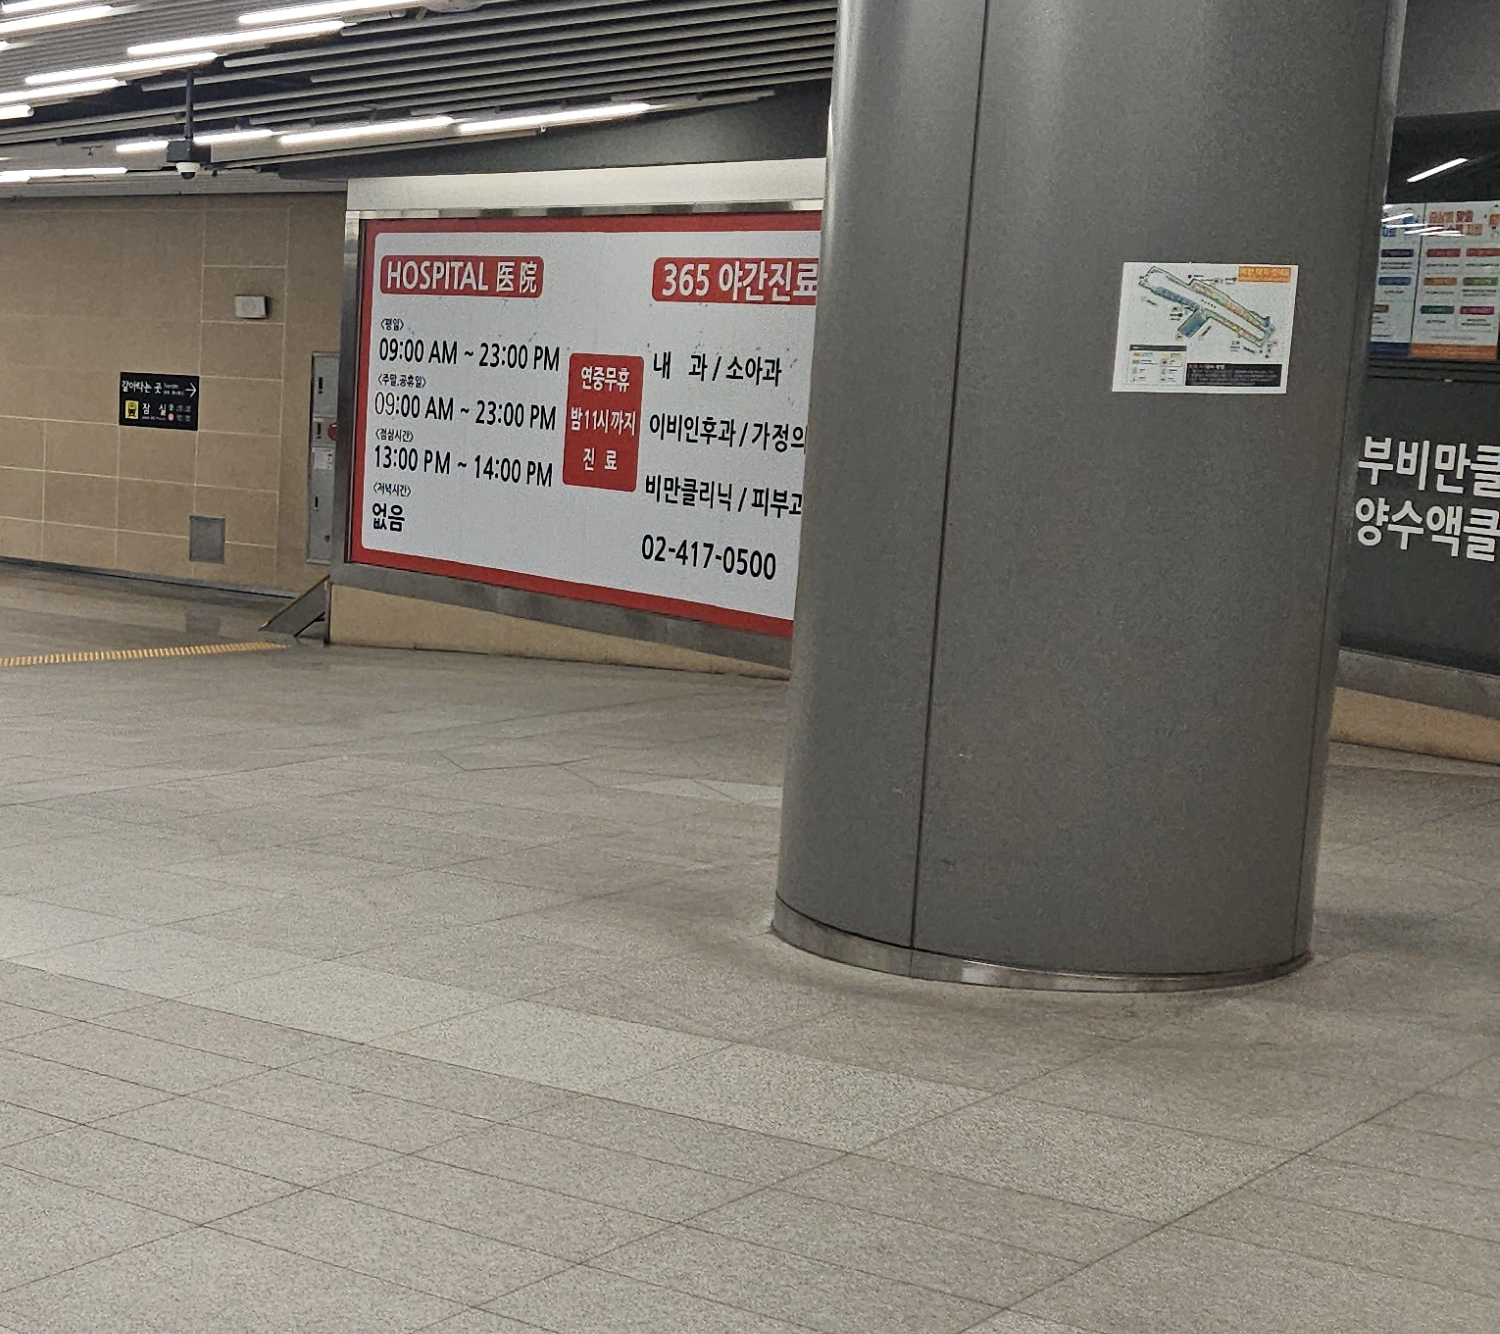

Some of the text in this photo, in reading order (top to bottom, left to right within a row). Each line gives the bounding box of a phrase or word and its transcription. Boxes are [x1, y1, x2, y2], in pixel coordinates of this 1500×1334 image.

[387, 260, 538, 294] HOSPITAL 医院
[662, 260, 818, 302] 365 야간진료
[379, 337, 424, 363] 09:00
[428, 340, 458, 365] AM
[479, 342, 528, 369] 23:00
[533, 345, 560, 371] PM
[654, 351, 671, 380] 내
[688, 353, 708, 382] 과
[726, 356, 782, 387] 소아과
[581, 366, 630, 392] 연중무휴
[374, 391, 421, 419] 09:00
[425, 397, 454, 421] AM
[475, 400, 524, 428] 23:00
[530, 404, 556, 431] PM
[650, 413, 736, 447] 이비인후과
[374, 445, 418, 471] 13:00
[424, 449, 450, 475] PM
[474, 455, 521, 483] 14:00
[526, 460, 552, 487] PM
[645, 475, 733, 512] 비만클리닉
[372, 503, 405, 533] 없음
[642, 534, 776, 580] 02-417-0500
